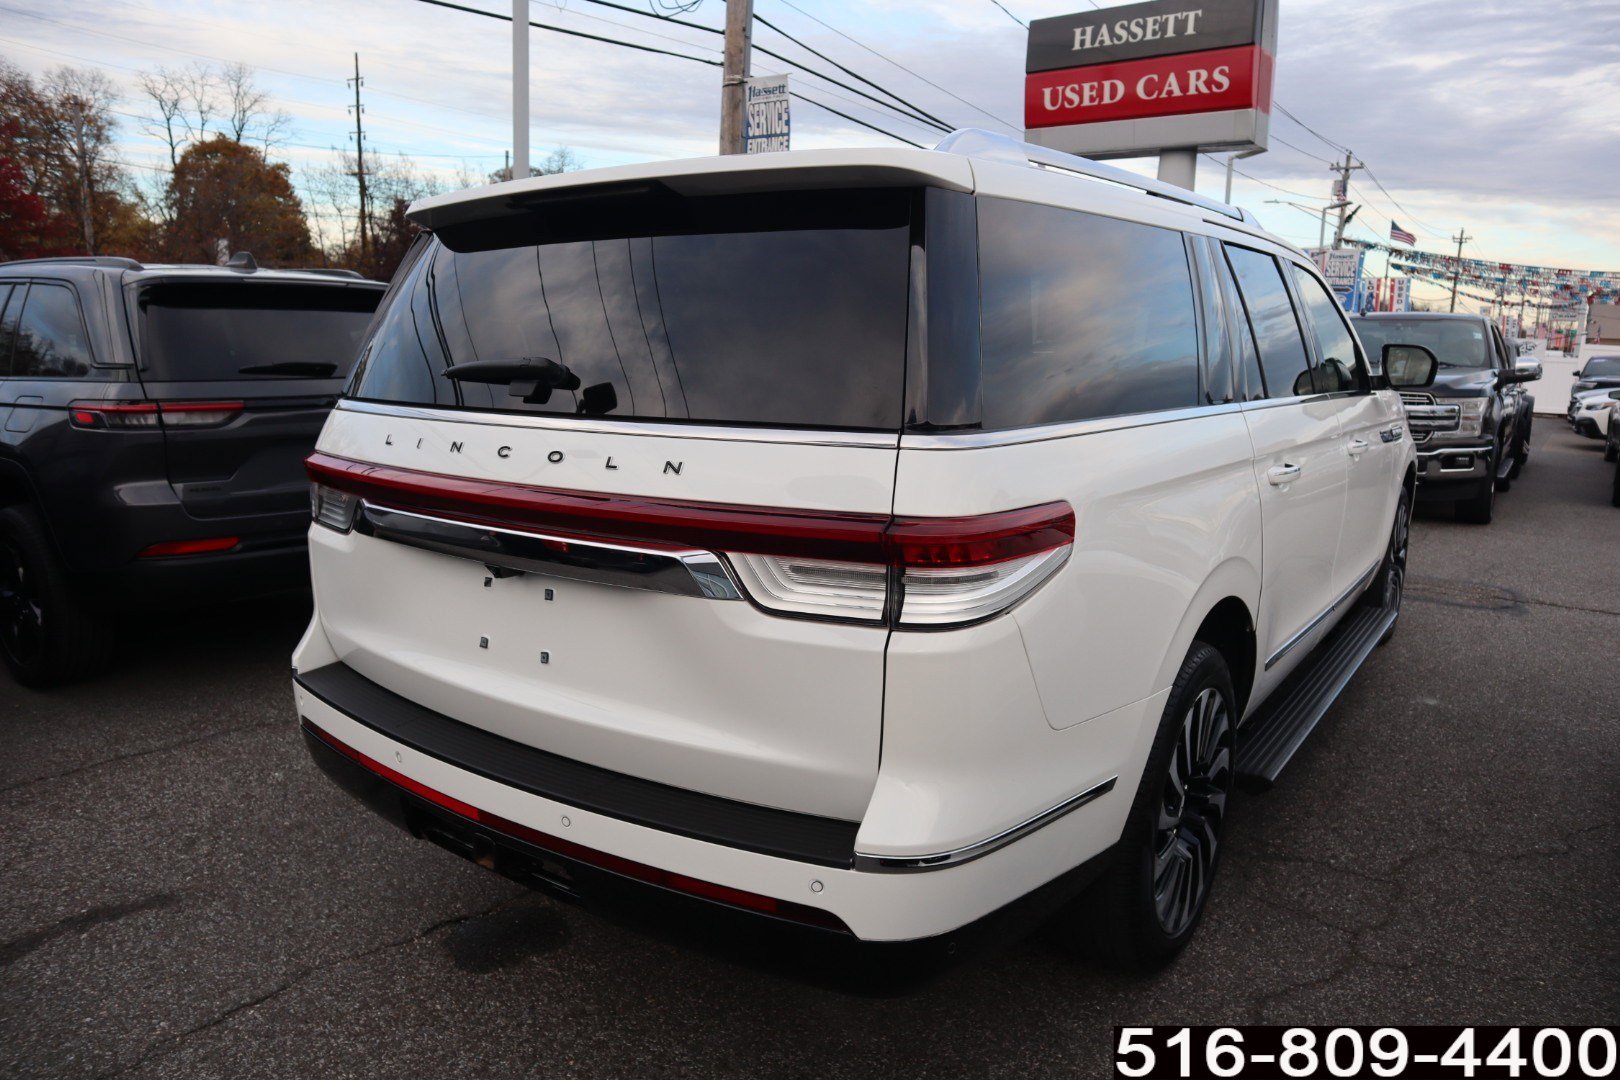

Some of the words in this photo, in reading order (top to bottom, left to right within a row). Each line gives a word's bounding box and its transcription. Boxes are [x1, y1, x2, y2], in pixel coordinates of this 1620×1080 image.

[1072, 9, 1203, 51] HASSETT
[748, 84, 786, 101] Hassett
[1042, 79, 1126, 111] USED
[1136, 65, 1231, 100] CARS
[748, 101, 788, 136] SERVICE
[747, 137, 789, 153] ENTRANCE
[1327, 261, 1355, 277] SERVICE
[385, 434, 684, 475] LINCOLN
